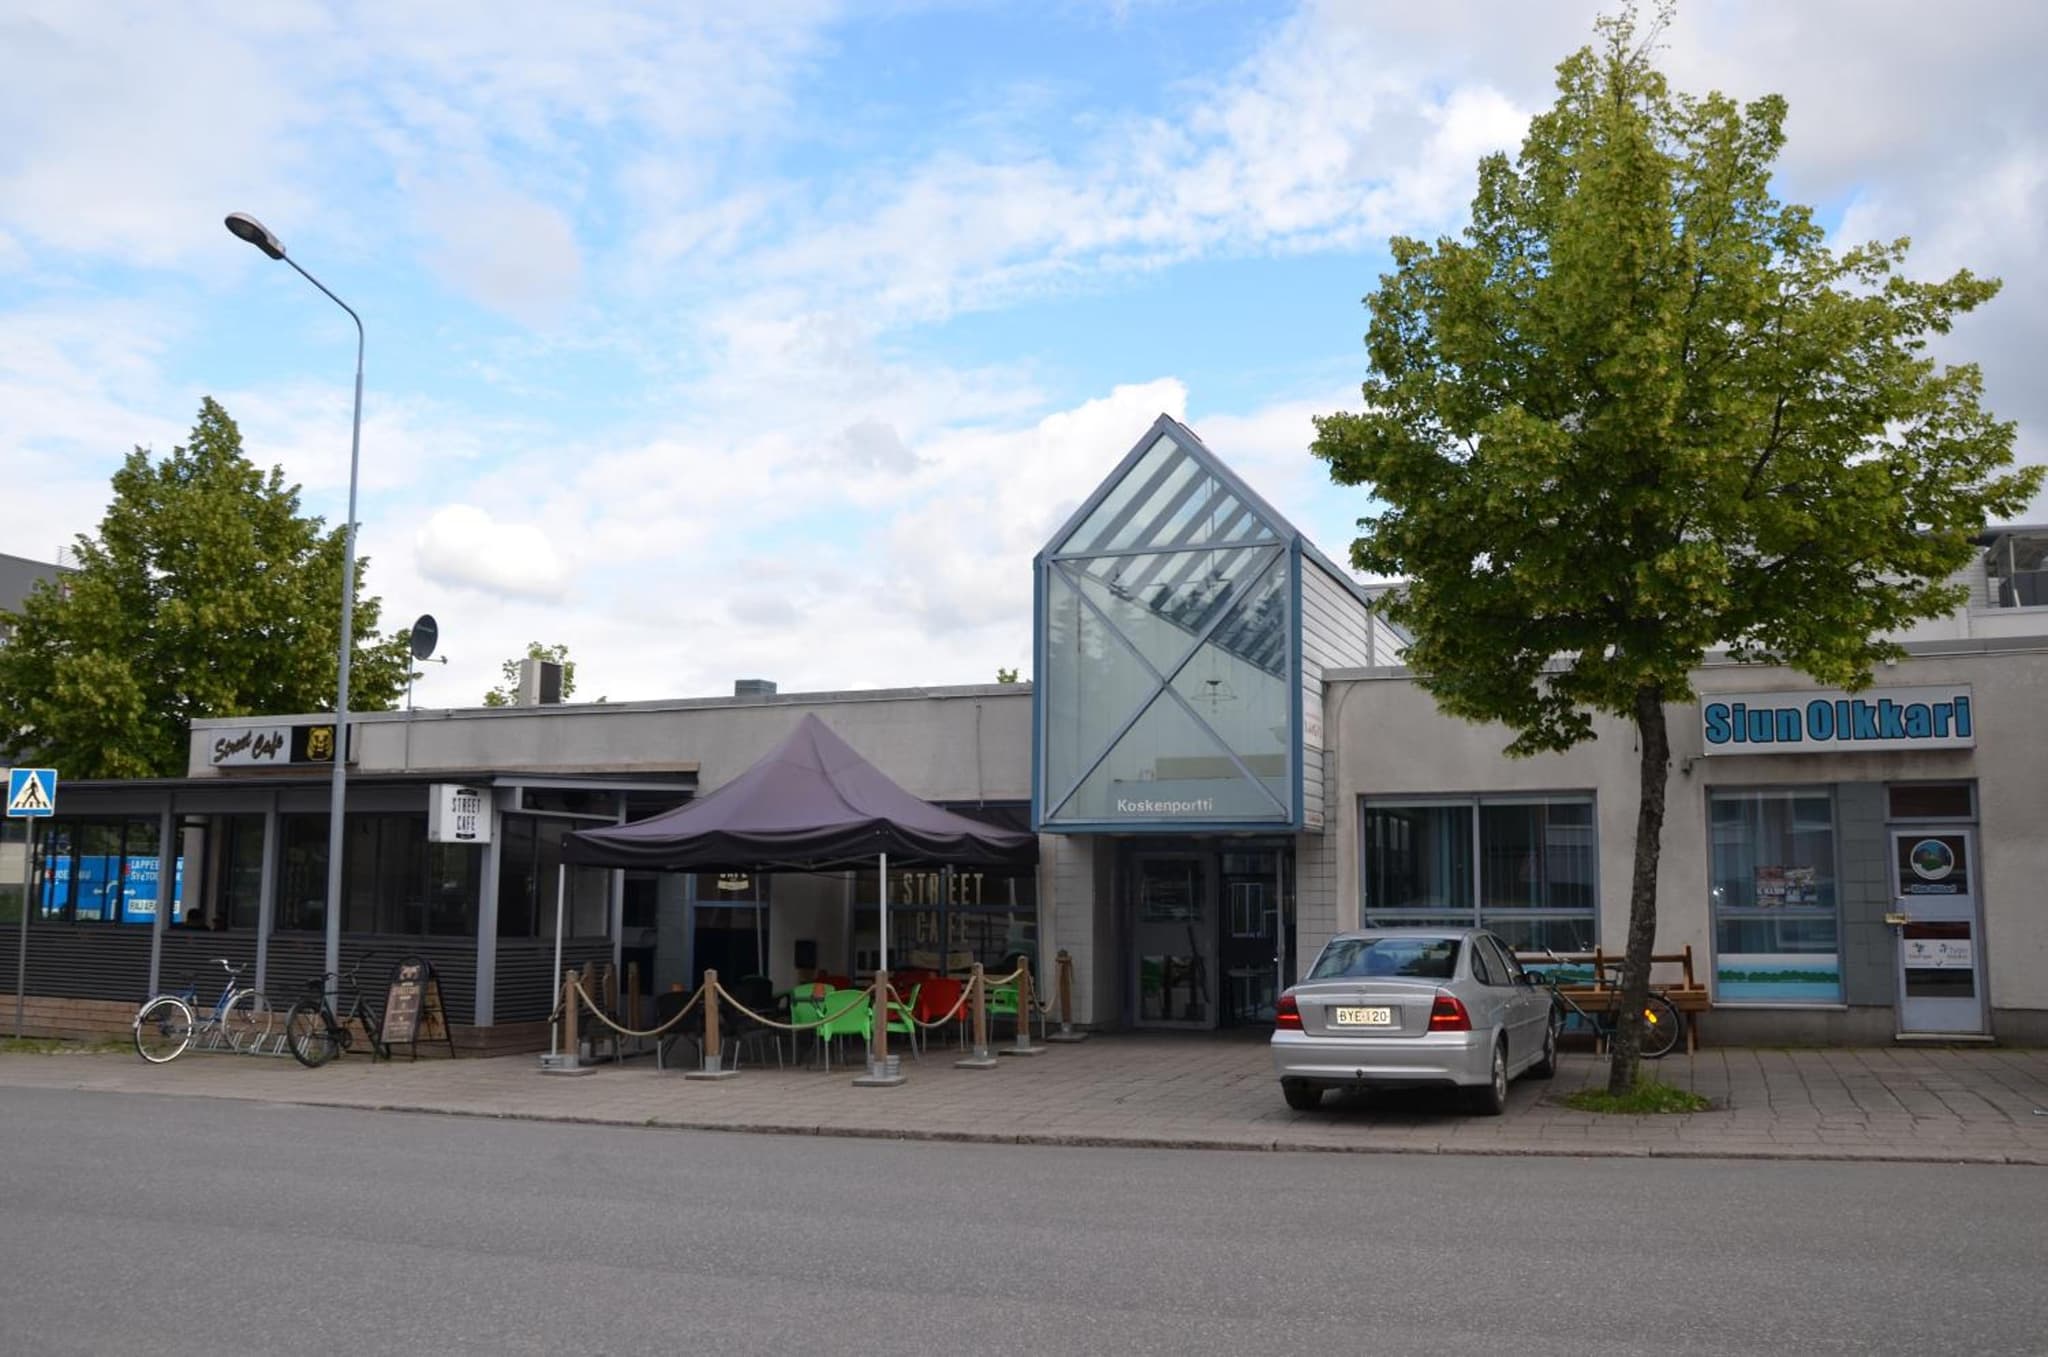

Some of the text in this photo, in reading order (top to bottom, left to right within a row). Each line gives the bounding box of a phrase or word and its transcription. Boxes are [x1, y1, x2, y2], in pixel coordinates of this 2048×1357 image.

[1704, 696, 1971, 744] Siun Olkkari
[212, 731, 252, 763] Street
[452, 797, 481, 814] STREET
[1117, 797, 1214, 813] Koskenportti
[456, 815, 476, 831] CAFE
[902, 872, 984, 905] STREET
